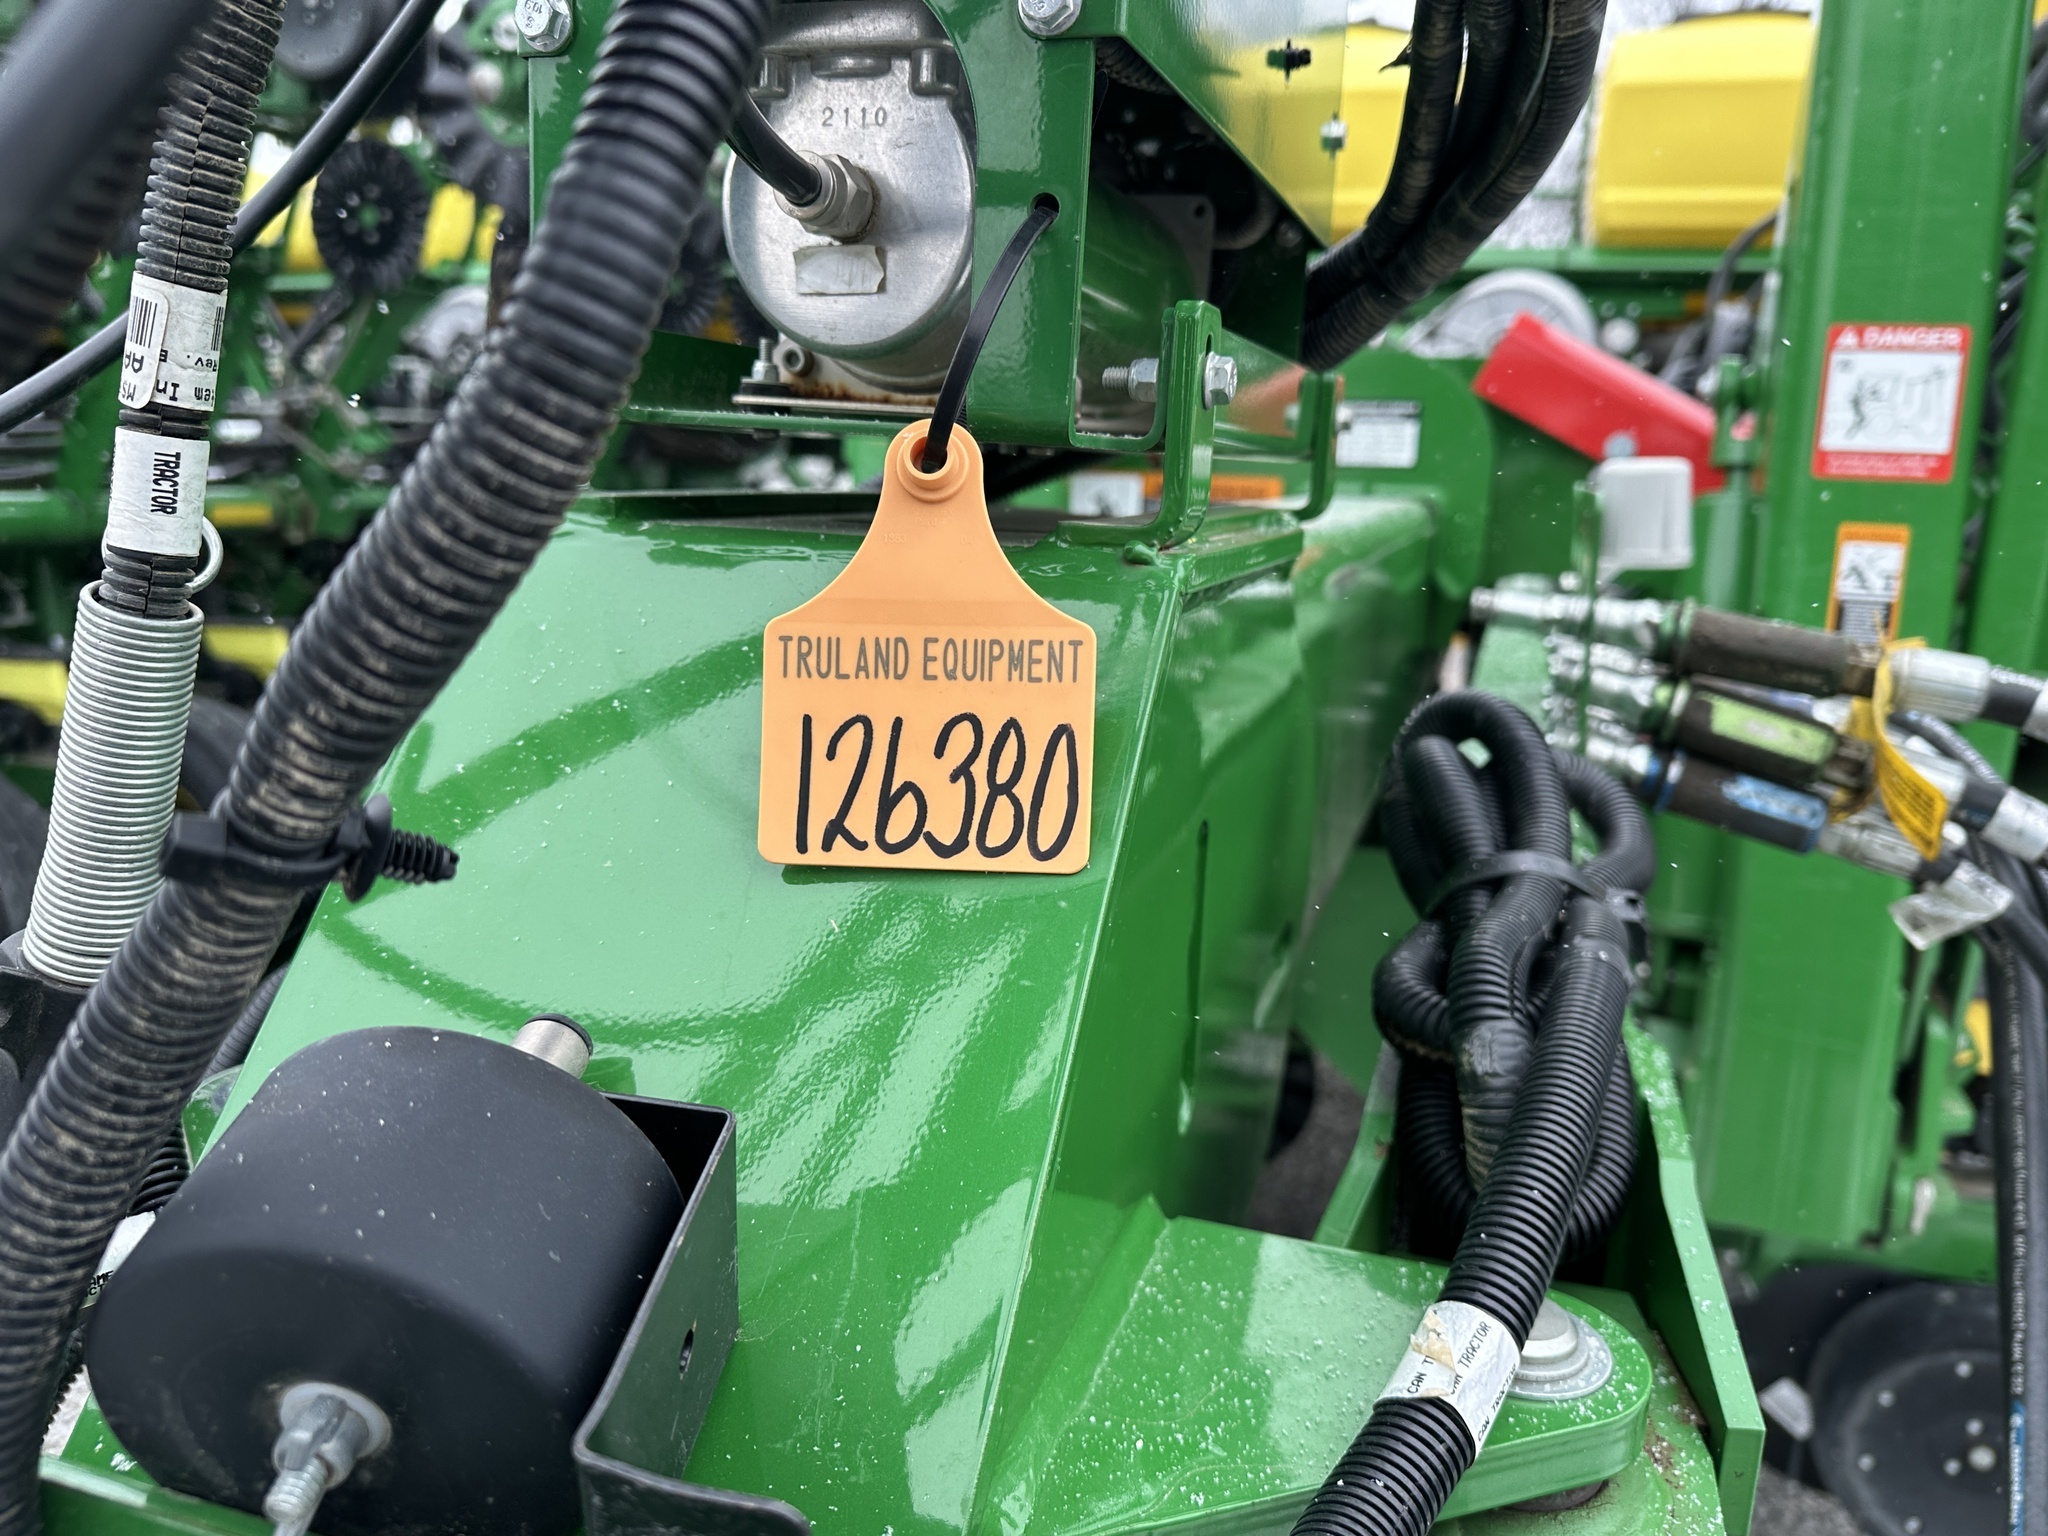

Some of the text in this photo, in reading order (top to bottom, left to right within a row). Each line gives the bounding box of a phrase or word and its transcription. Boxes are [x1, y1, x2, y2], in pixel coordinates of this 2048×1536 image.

[821, 106, 888, 130] 2110
[150, 452, 181, 515] TRACTOR
[778, 635, 1084, 683] TRULAND EQUIPMENT
[796, 712, 1079, 862] 126380
[1457, 1321, 1492, 1368] TRACTOR
[1407, 1371, 1427, 1394] CAN
